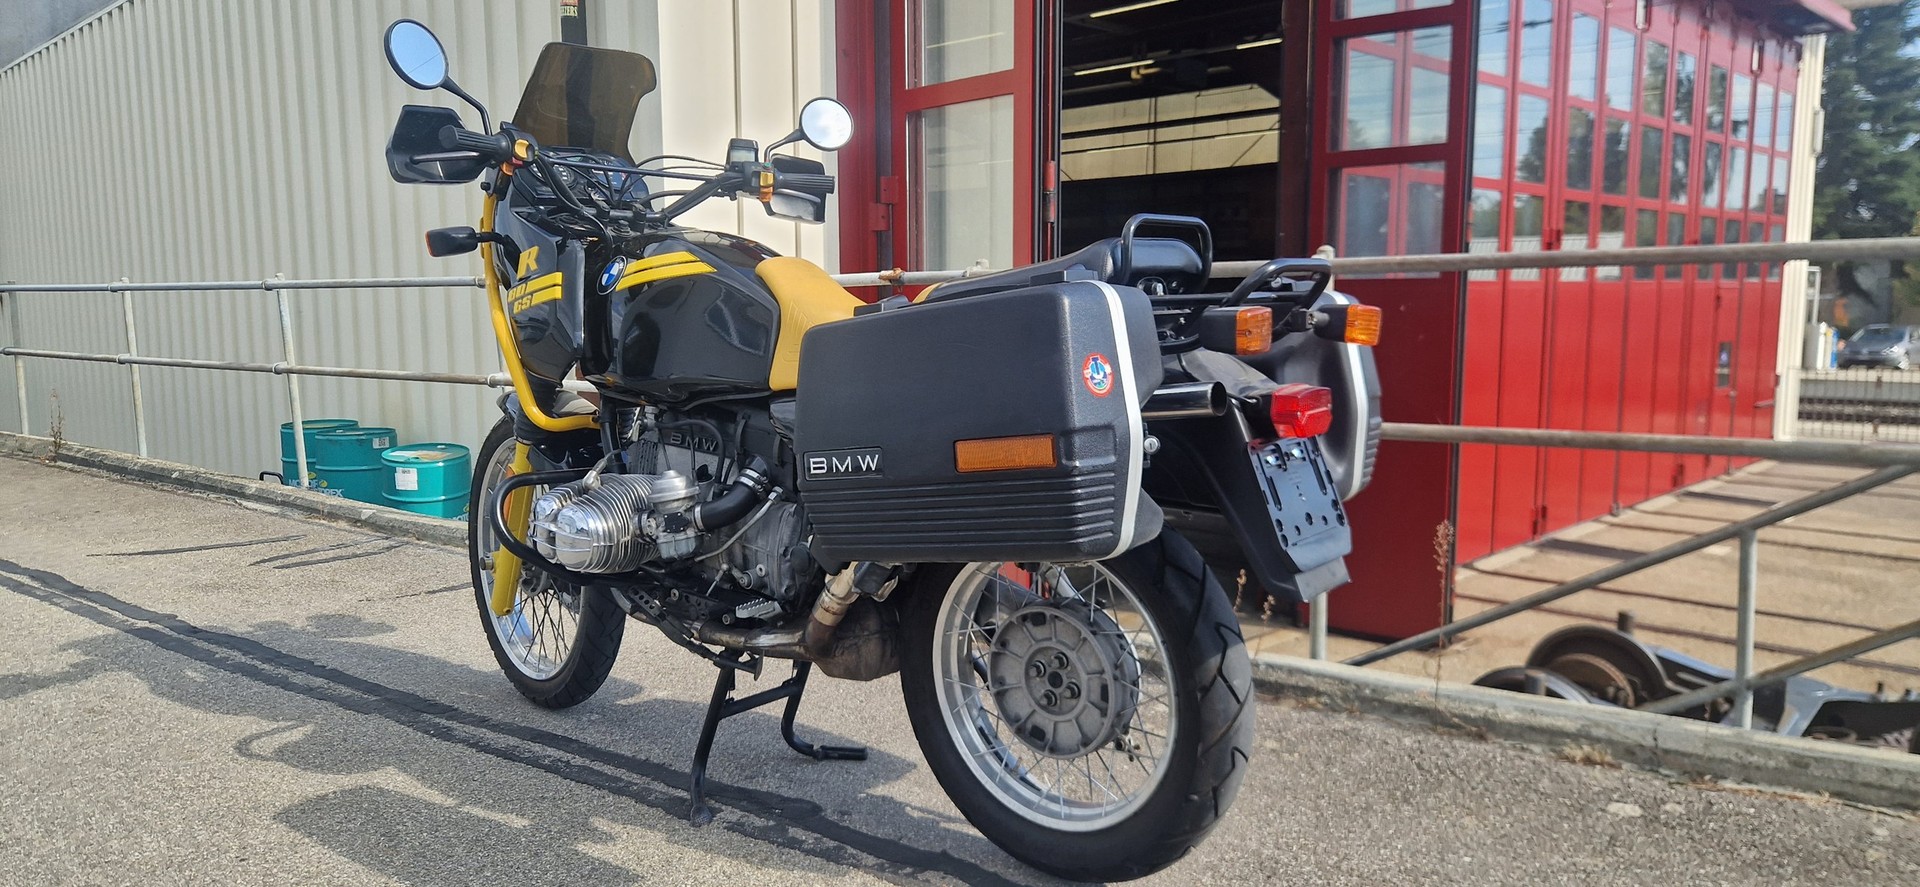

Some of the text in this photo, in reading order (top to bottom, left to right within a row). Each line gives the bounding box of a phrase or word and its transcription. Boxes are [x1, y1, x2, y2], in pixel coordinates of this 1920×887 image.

[516, 245, 540, 280] R
[513, 296, 532, 315] GS
[670, 431, 717, 452] BMW
[809, 454, 879, 474] BMW
